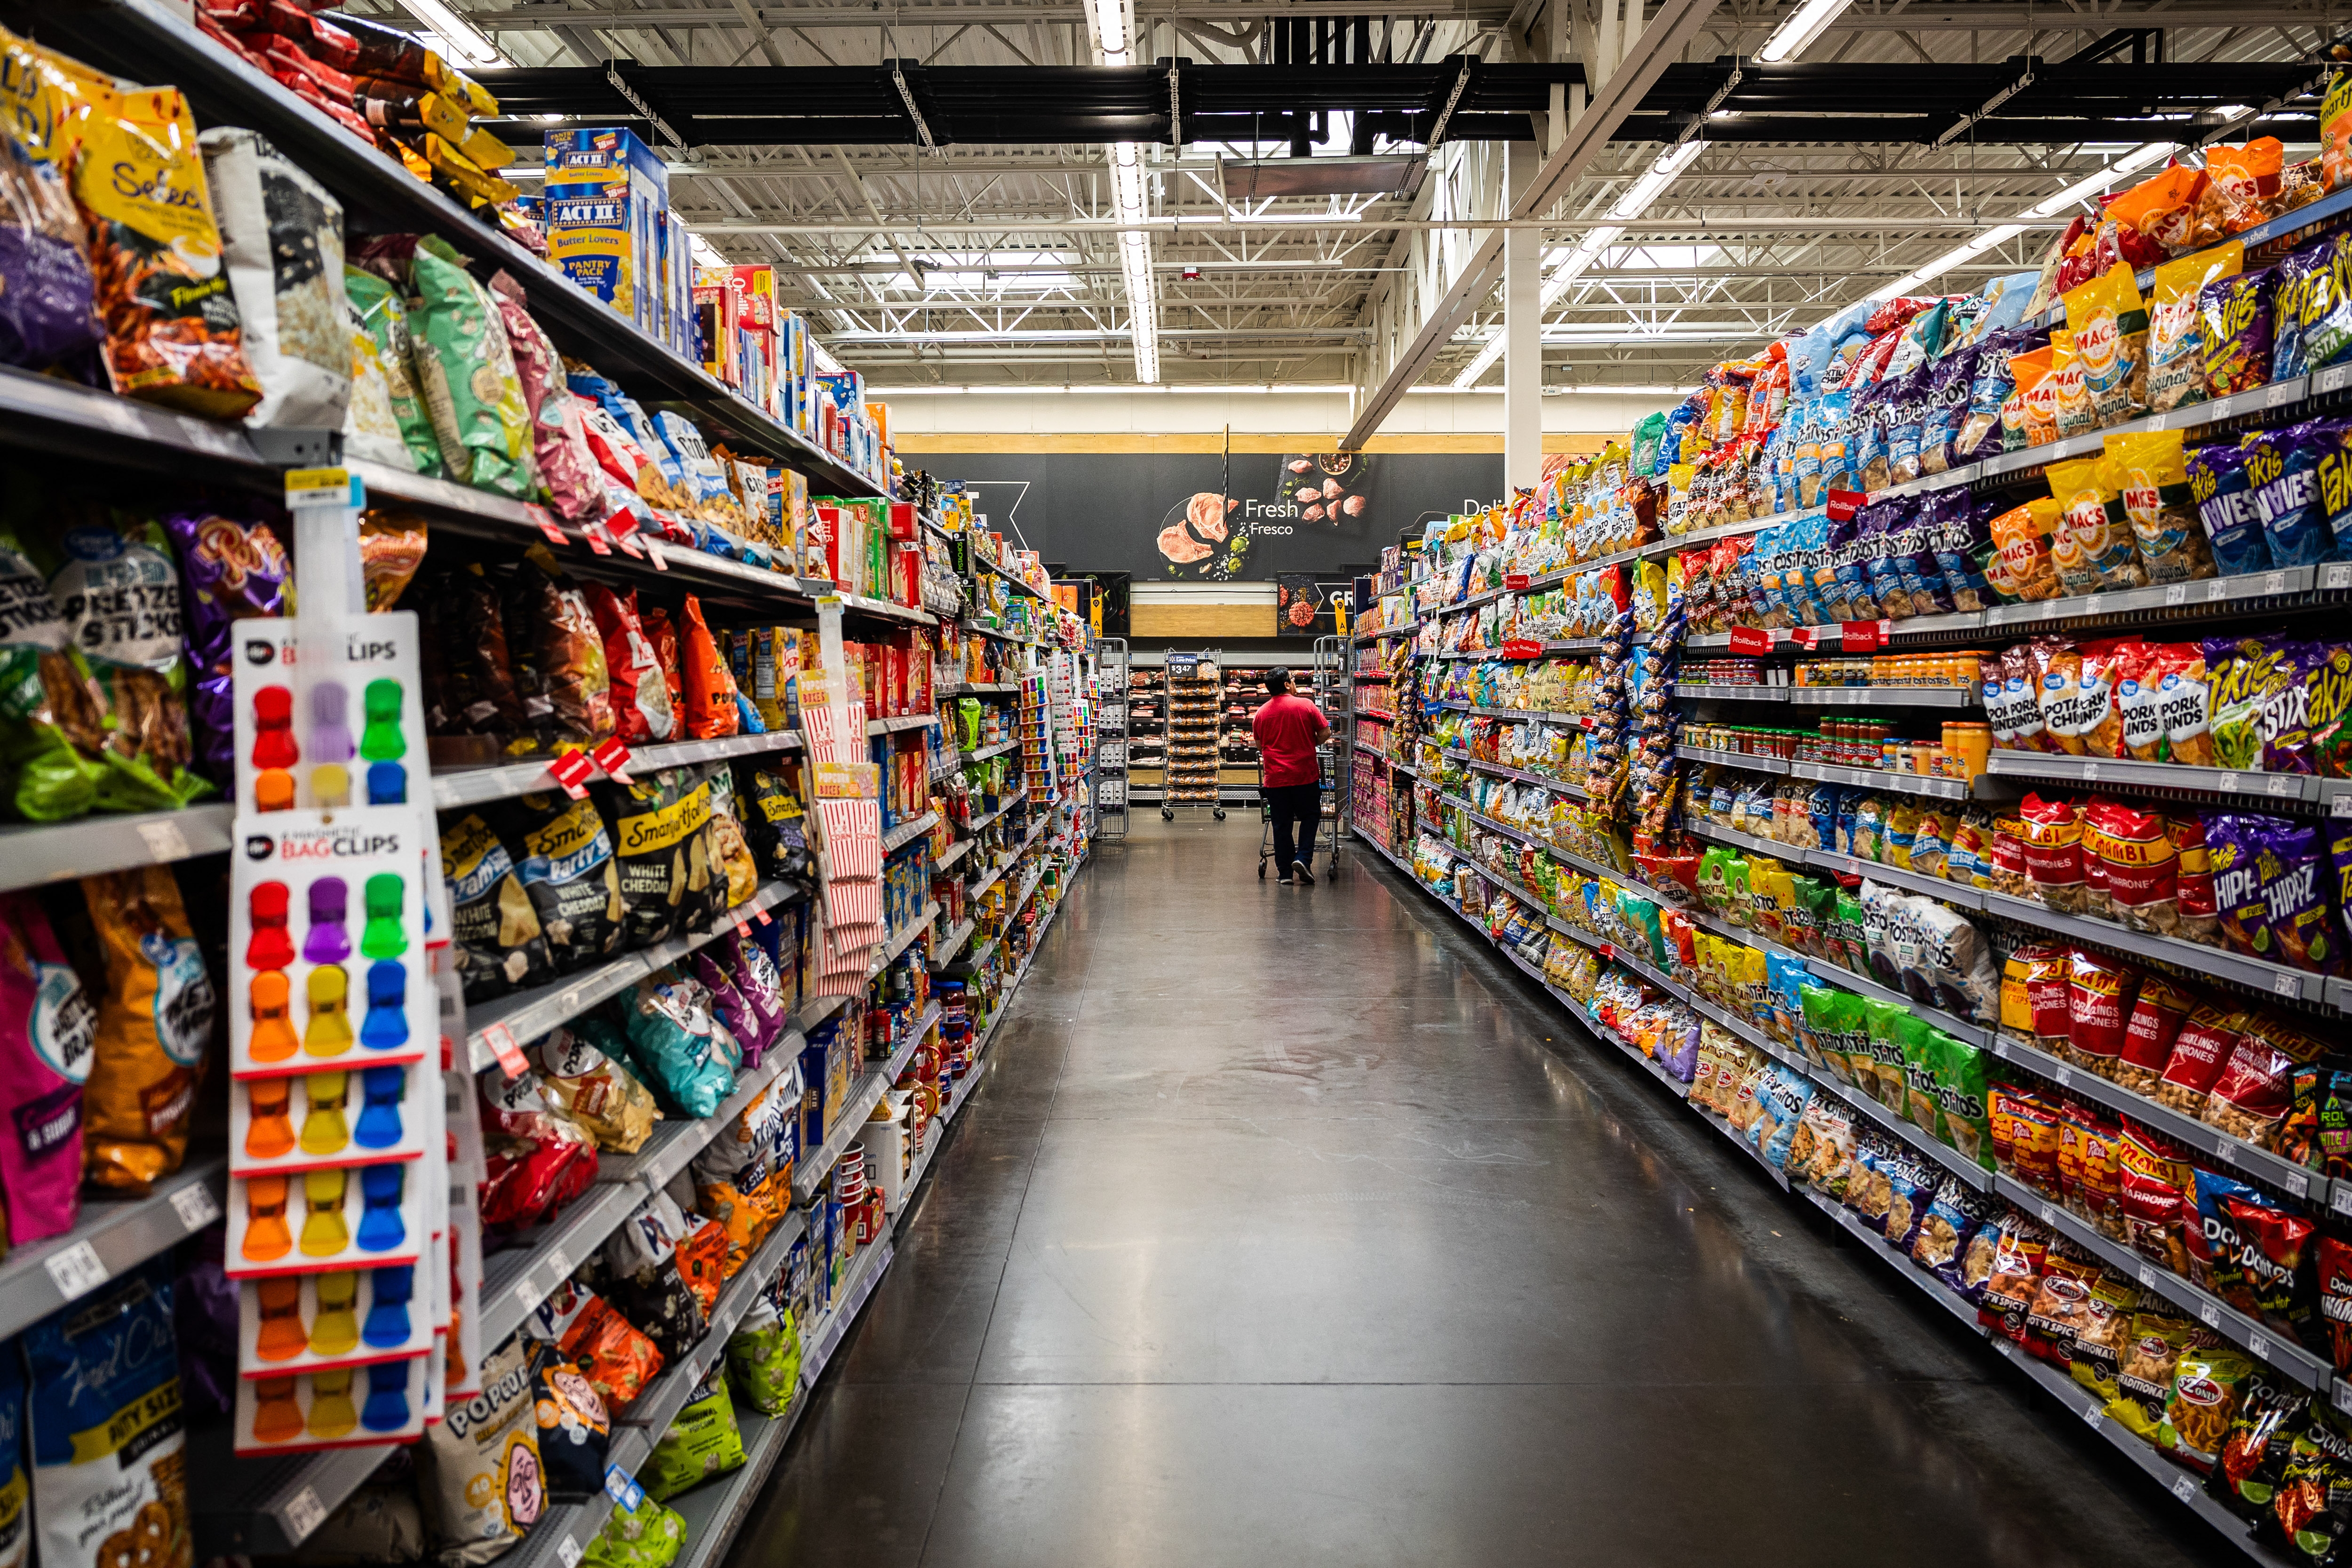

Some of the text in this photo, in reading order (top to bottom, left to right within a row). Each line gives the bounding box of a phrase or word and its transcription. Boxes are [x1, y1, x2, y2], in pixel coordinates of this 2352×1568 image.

[596, 140, 606, 150] 18
[570, 155, 602, 164] ACT II
[560, 205, 614, 221] ACT II
[557, 234, 619, 247] Butter Lovers
[2249, 226, 2269, 243] shelf.
[569, 261, 612, 270] PANTRY
[577, 268, 603, 277] PACK
[2137, 276, 2146, 287] for
[732, 277, 749, 317] Orville
[2074, 320, 2118, 353] MAC'S
[2215, 348, 2230, 365] FUEGO
[1463, 499, 1502, 516] Deli
[2256, 470, 2321, 528] WAVES
[1246, 499, 1298, 518] Fresh
[2201, 488, 2259, 540] WAVES
[2067, 507, 2106, 530] MAC'S
[1250, 522, 1294, 536] Fresco
[2002, 543, 2034, 563] MAC'S
[82, 612, 183, 646] STICKS
[1843, 631, 1873, 641] Rollback
[1732, 635, 1762, 647] Rollback
[803, 692, 825, 703] BOXES
[2170, 688, 2187, 700] FRIED
[2011, 697, 2038, 716] PORK
[2122, 703, 2156, 719] PORK
[2162, 694, 2201, 716] PORK
[2265, 685, 2311, 742] STIX
[2011, 712, 2041, 728] RINDS
[2164, 709, 2203, 732] RINDS
[813, 739, 835, 748] CORN
[2277, 734, 2297, 746] FUEGO
[818, 785, 840, 795] BOXES
[281, 835, 399, 860] BAGCLIPS
[2097, 839, 2147, 862] MAMBI
[2209, 847, 2237, 873] Takis
[628, 863, 667, 880] WHITE
[555, 883, 593, 901] WHITE
[621, 877, 669, 894] CHEDDAR
[557, 896, 607, 917] CHEDDAR
[2235, 1045, 2253, 1064] PORK
[2121, 1143, 2178, 1181] MAMBI
[2241, 1245, 2294, 1288] Doritos
[2046, 1278, 2060, 1290] $2
[2060, 1287, 2079, 1299] ONLY
[2275, 1294, 2291, 1308] Hot
[1999, 1296, 2026, 1312] SPICY
[2179, 1376, 2195, 1394] $2
[2195, 1389, 2218, 1402] ONLY
[679, 1406, 718, 1429] ORIGINAL
